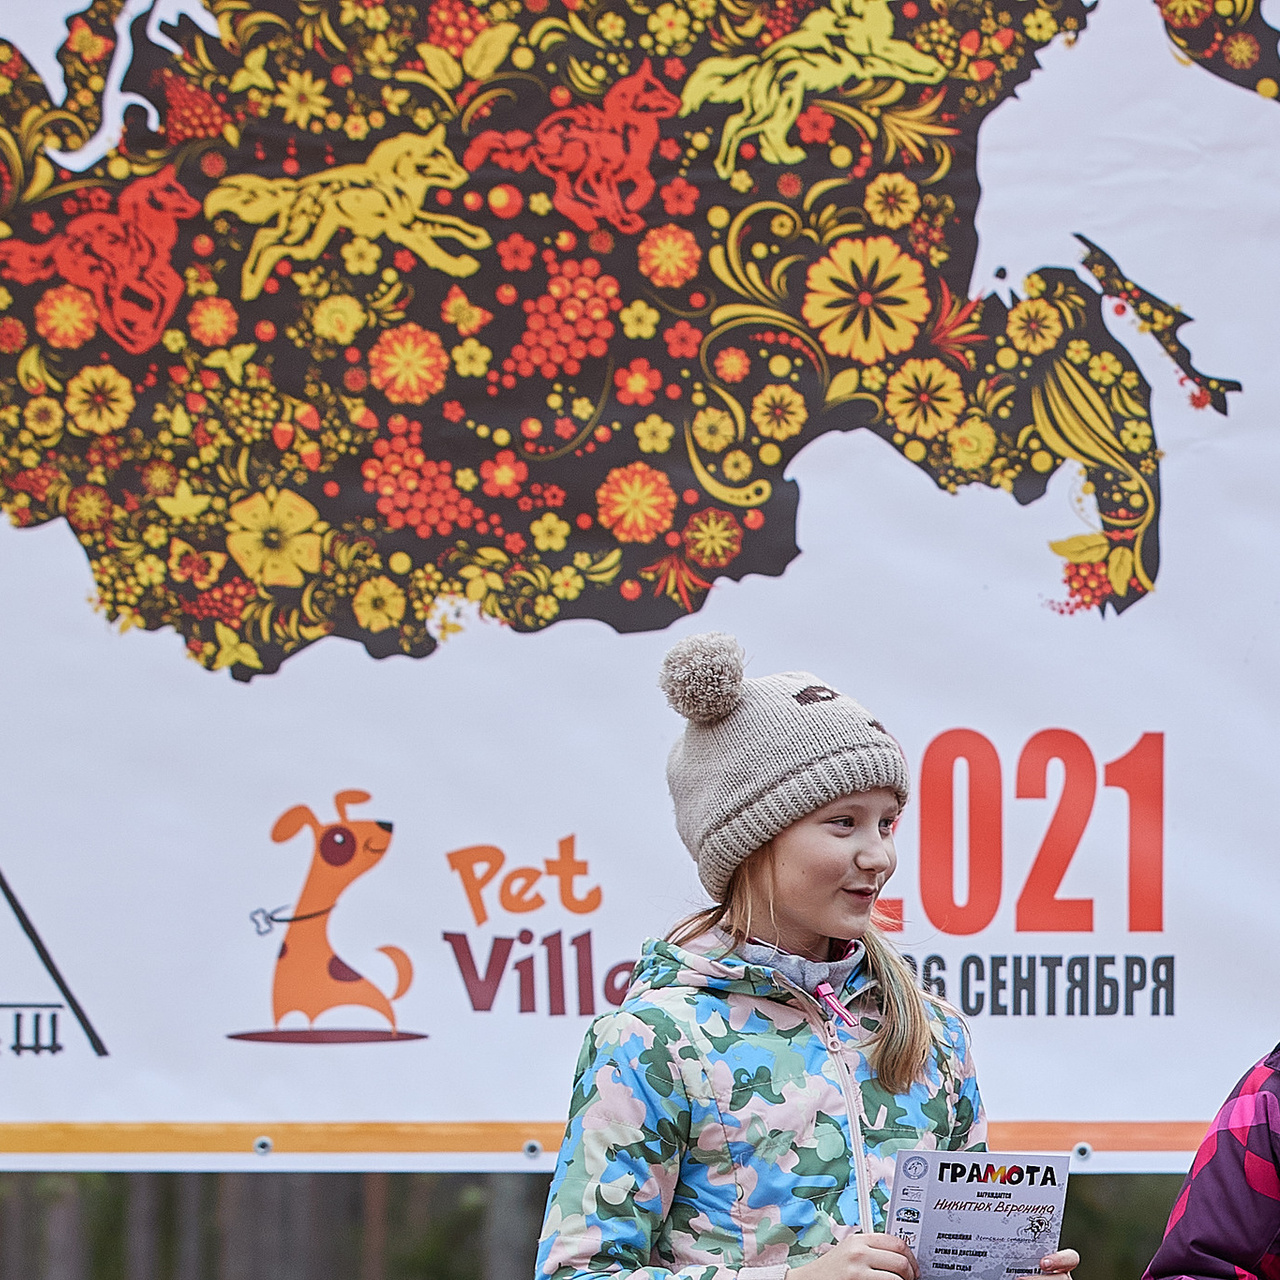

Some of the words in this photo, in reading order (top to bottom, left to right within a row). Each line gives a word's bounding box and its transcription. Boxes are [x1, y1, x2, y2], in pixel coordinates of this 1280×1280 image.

[873, 727, 1165, 936] 021
[446, 833, 603, 927] Pet
[960, 955, 1175, 1016] СЕНТЯБРЯ
[938, 1162, 1057, 1186] ГРАМОТА
